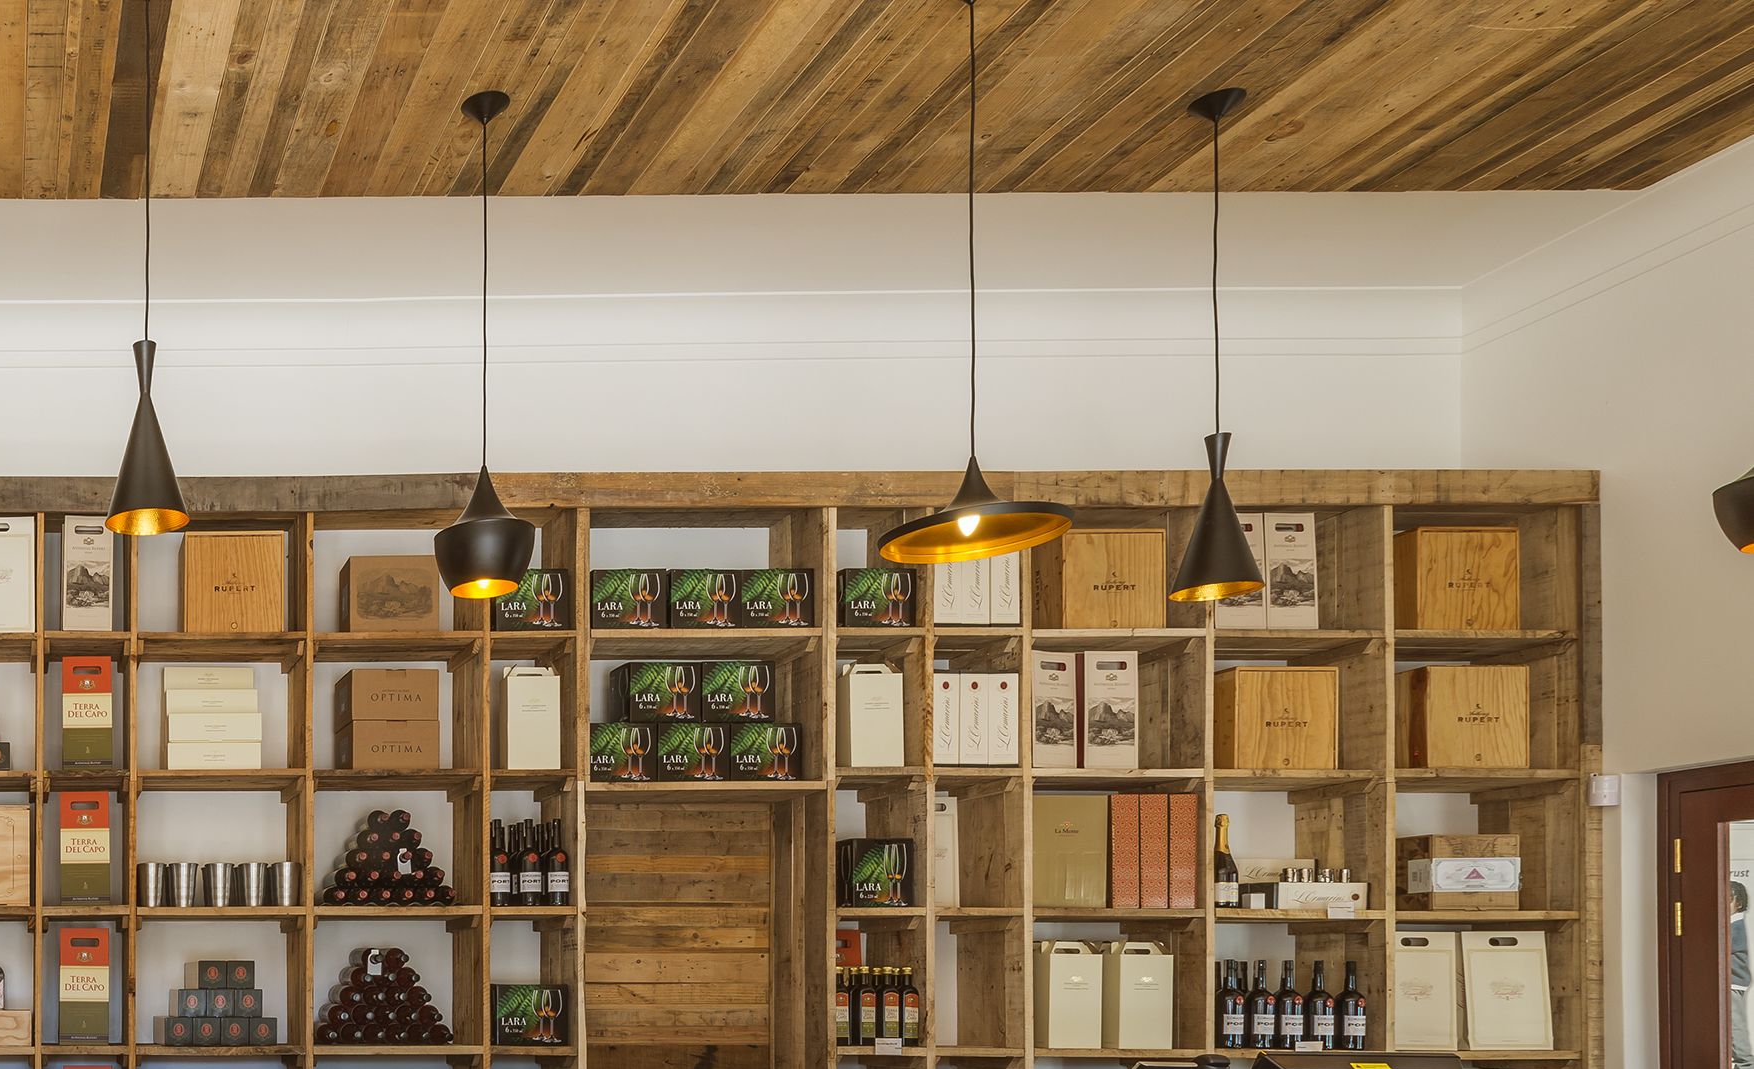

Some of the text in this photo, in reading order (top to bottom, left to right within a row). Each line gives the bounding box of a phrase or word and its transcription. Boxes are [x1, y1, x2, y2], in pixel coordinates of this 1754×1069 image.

[501, 602, 527, 610] LARA
[597, 602, 623, 610] LARA
[676, 601, 701, 609] LARA
[746, 601, 772, 610] LARA
[851, 600, 876, 609] LARA
[371, 693, 422, 701] OPTIMA
[635, 694, 661, 702] LARA
[707, 694, 733, 702] LARA
[85, 710, 108, 718] CAPO
[371, 744, 423, 753] OPTIMA
[590, 755, 615, 763] LARA
[663, 755, 688, 763] LARA
[736, 755, 761, 763] LARA
[83, 846, 106, 854] CAPO
[856, 883, 881, 891] LARA
[64, 983, 105, 991] DEL CAPO
[501, 1017, 527, 1025] LARA
